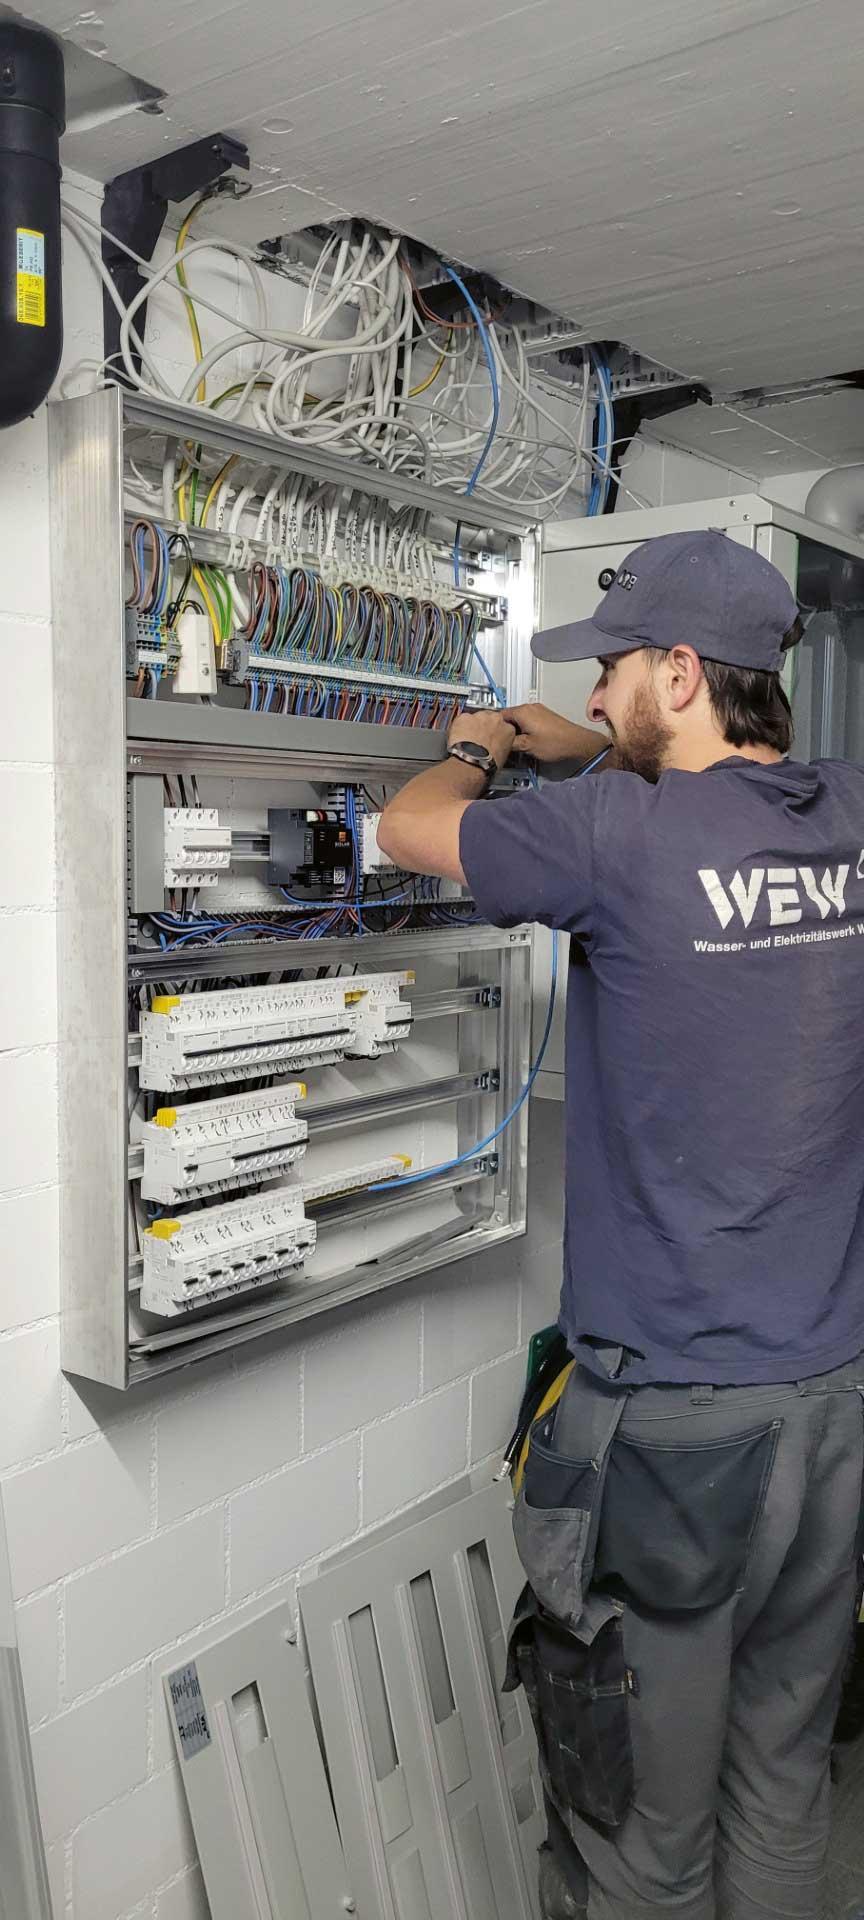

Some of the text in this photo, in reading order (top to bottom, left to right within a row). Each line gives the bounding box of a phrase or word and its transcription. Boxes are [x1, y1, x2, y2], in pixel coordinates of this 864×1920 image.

[697, 864, 850, 930] WEW
[694, 940, 746, 952] Wasser-
[750, 936, 771, 949] und
[774, 925, 855, 948] Elektrizitätswerk
